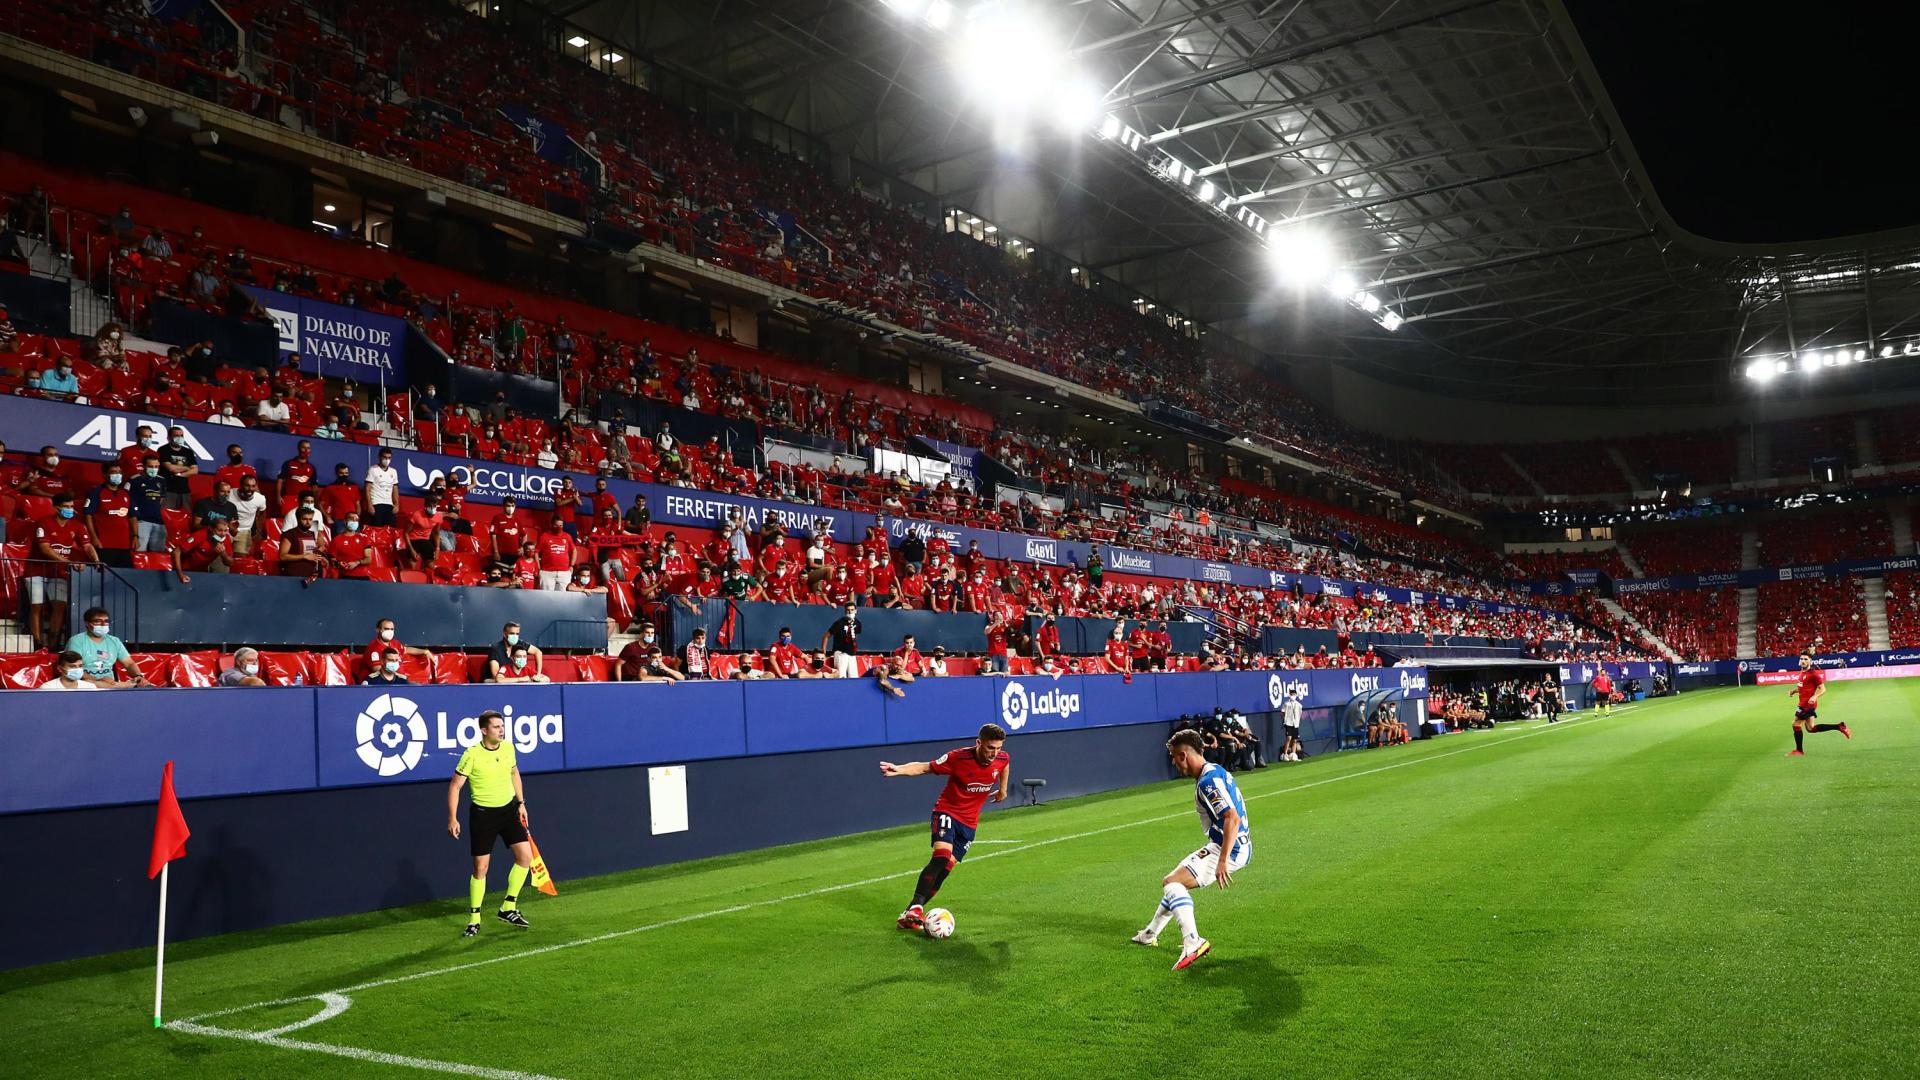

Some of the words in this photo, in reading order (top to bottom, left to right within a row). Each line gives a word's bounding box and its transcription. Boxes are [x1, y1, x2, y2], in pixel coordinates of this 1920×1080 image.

[305, 316, 366, 341] DIARIO
[368, 328, 391, 346] DE
[305, 337, 393, 369] NAVARRA
[666, 495, 758, 525] FERRETEIA
[762, 508, 835, 533] BRRIAIZ
[1620, 581, 1660, 592] euskaltel
[1031, 688, 1080, 718] LaLiga
[437, 705, 563, 753] Laiga
[940, 815, 951, 829] 11
